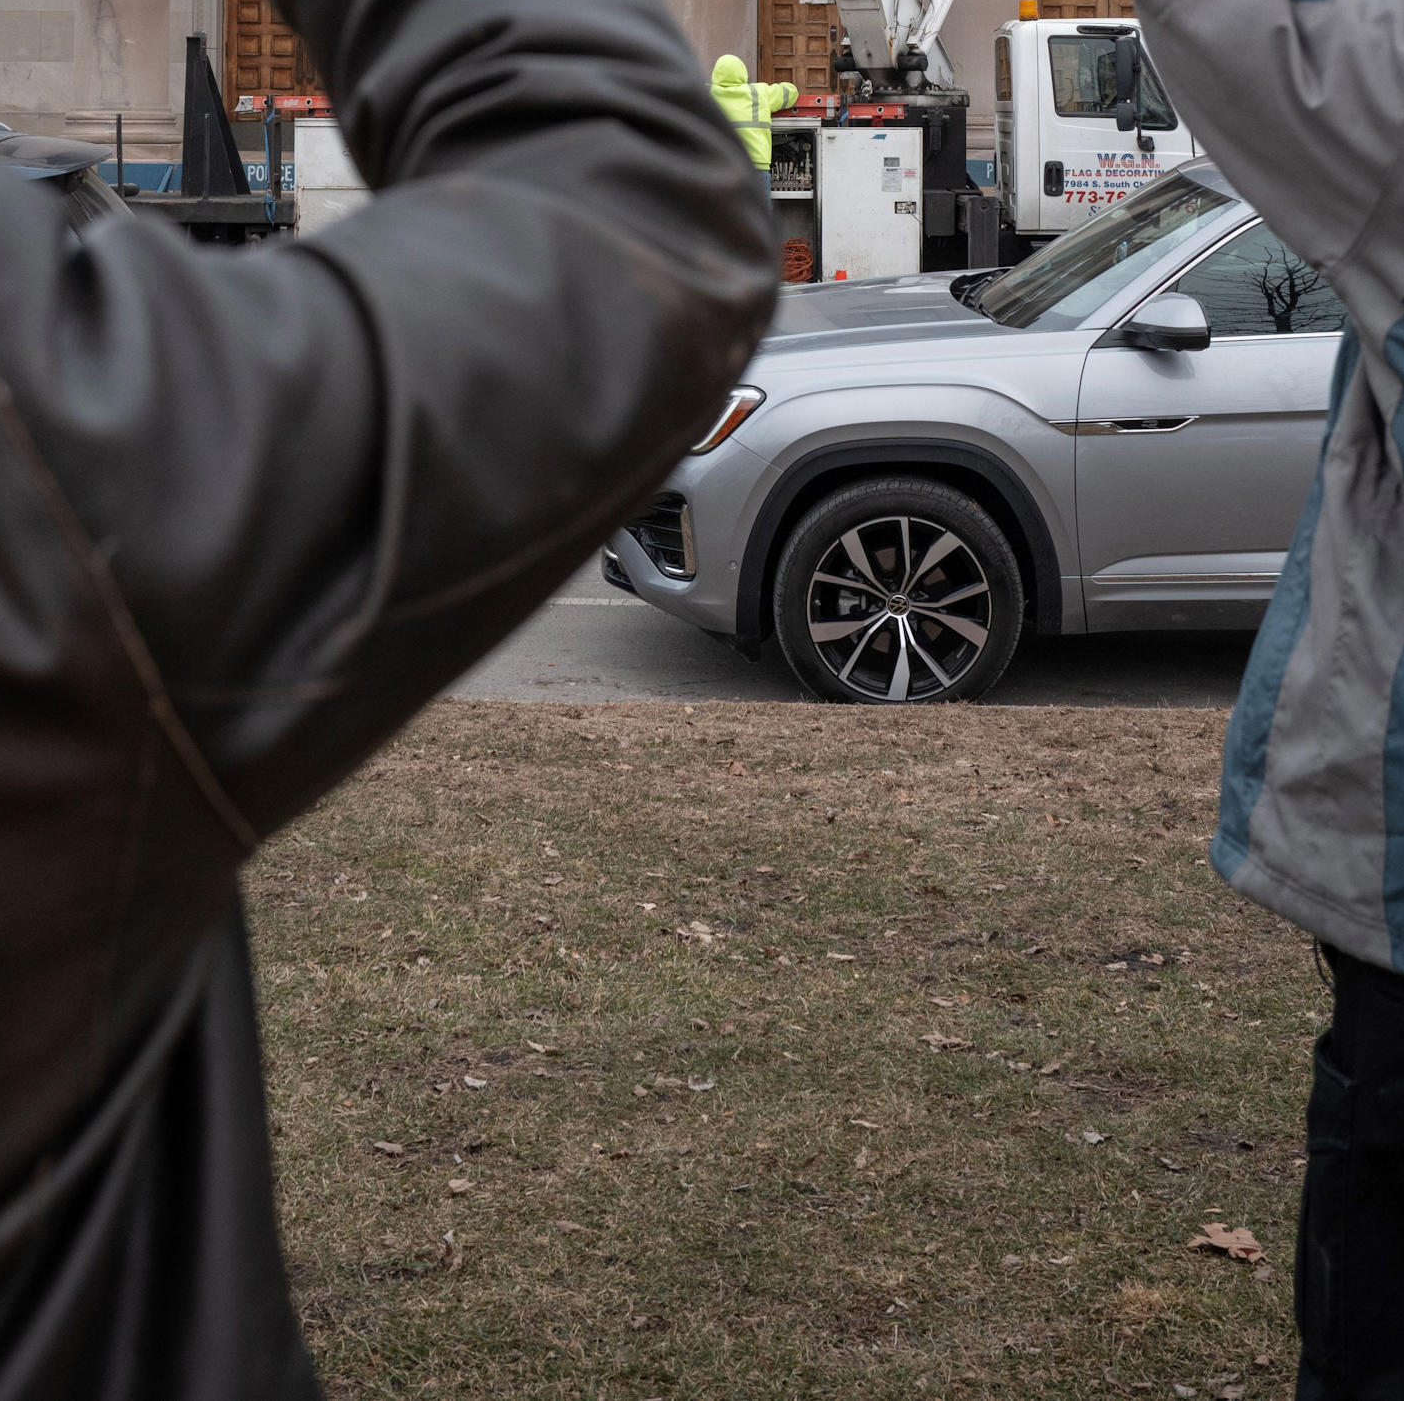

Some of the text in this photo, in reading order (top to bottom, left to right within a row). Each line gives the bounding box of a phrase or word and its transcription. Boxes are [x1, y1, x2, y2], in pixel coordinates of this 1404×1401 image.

[1097, 152, 1161, 169] W.G.N.
[1064, 169, 1093, 178] FLAG
[1095, 169, 1103, 178] &
[1064, 180, 1090, 188] 7984
[1092, 180, 1101, 188] S.
[1103, 180, 1131, 188] South
